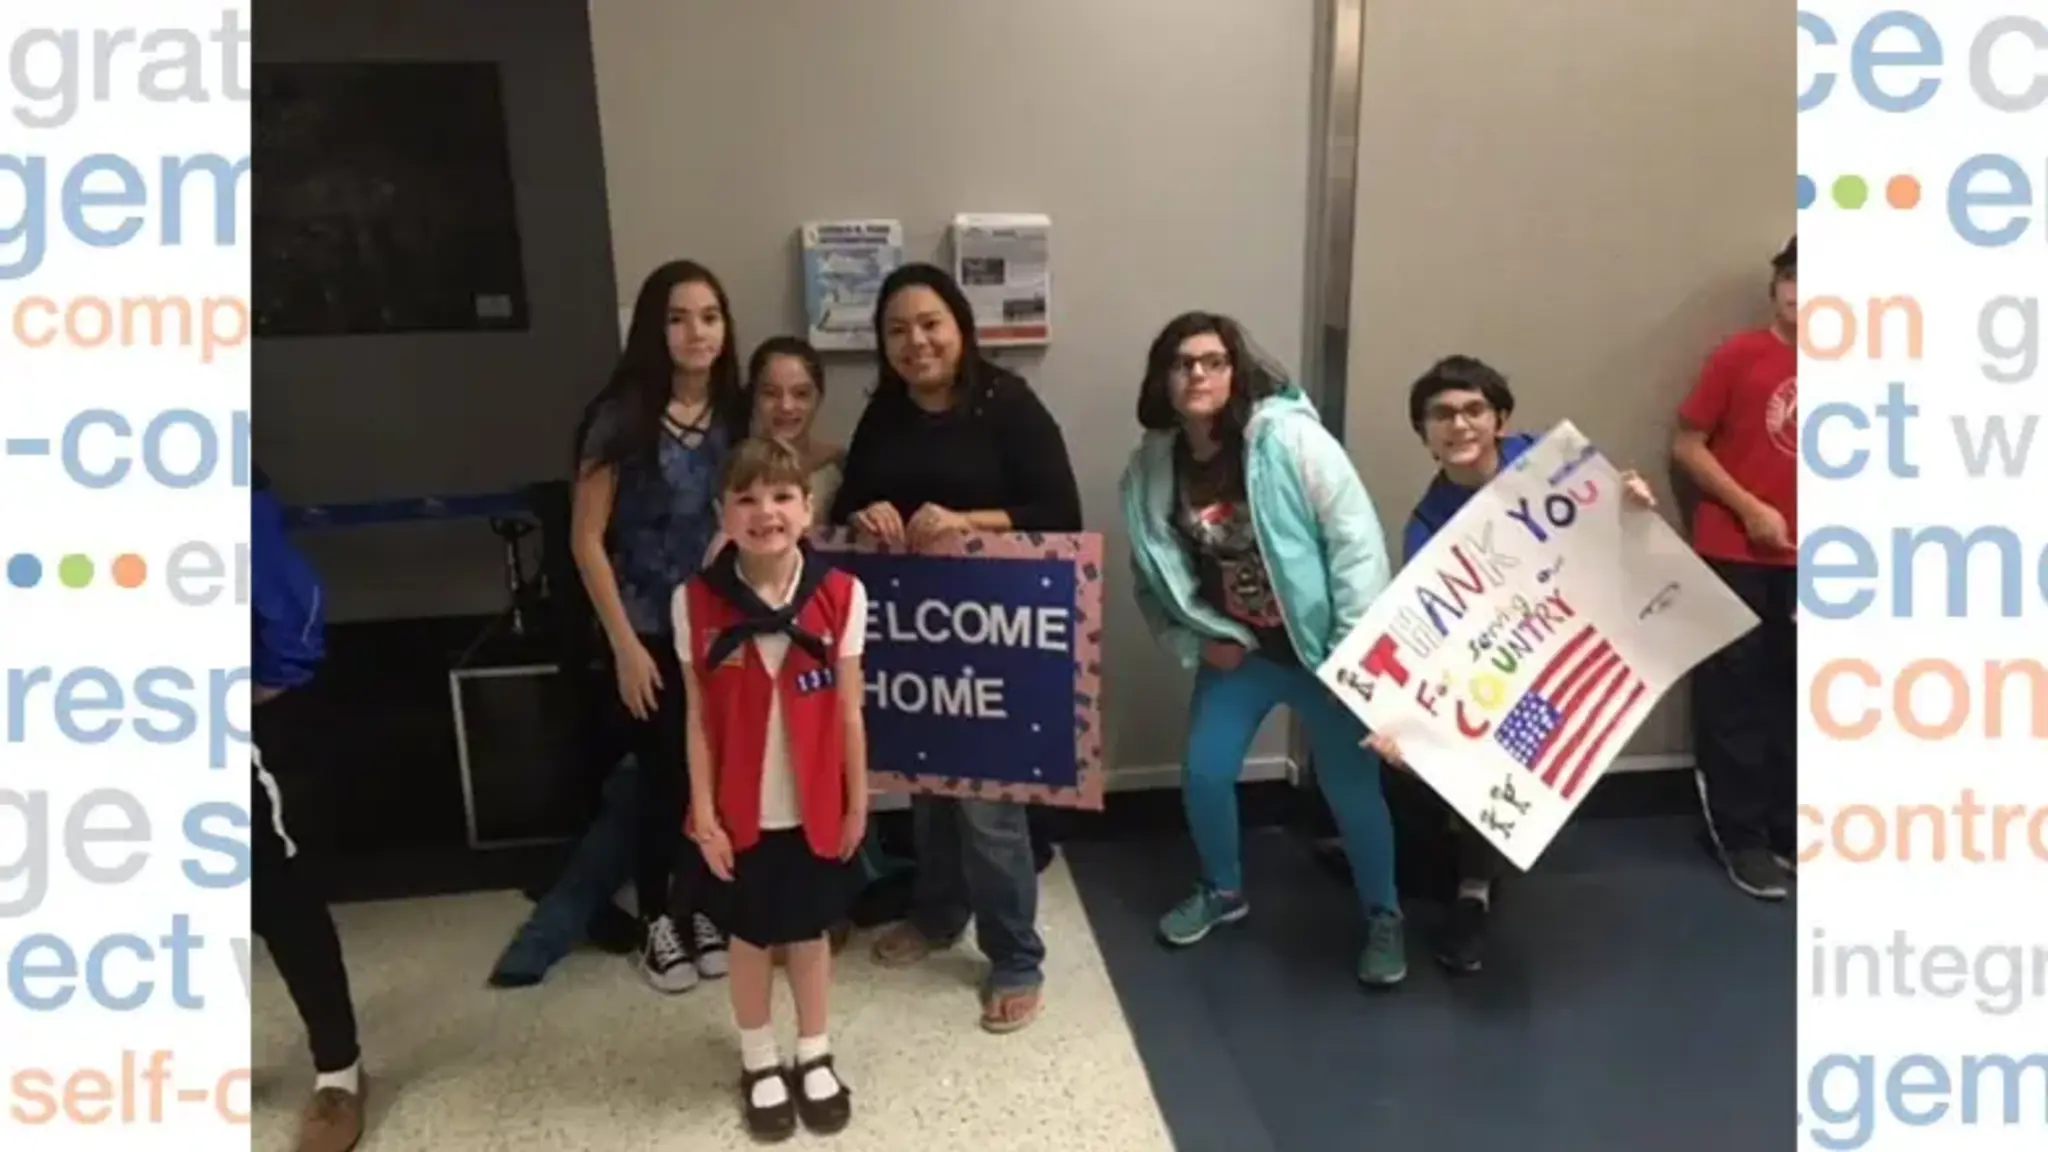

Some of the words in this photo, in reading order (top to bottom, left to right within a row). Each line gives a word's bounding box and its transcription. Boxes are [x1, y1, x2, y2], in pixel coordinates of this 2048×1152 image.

[866, 598, 1069, 651] ELCOME
[1358, 519, 1521, 689] THANK
[1505, 478, 1599, 544] YOU
[1456, 586, 1576, 740] COUNTRY
